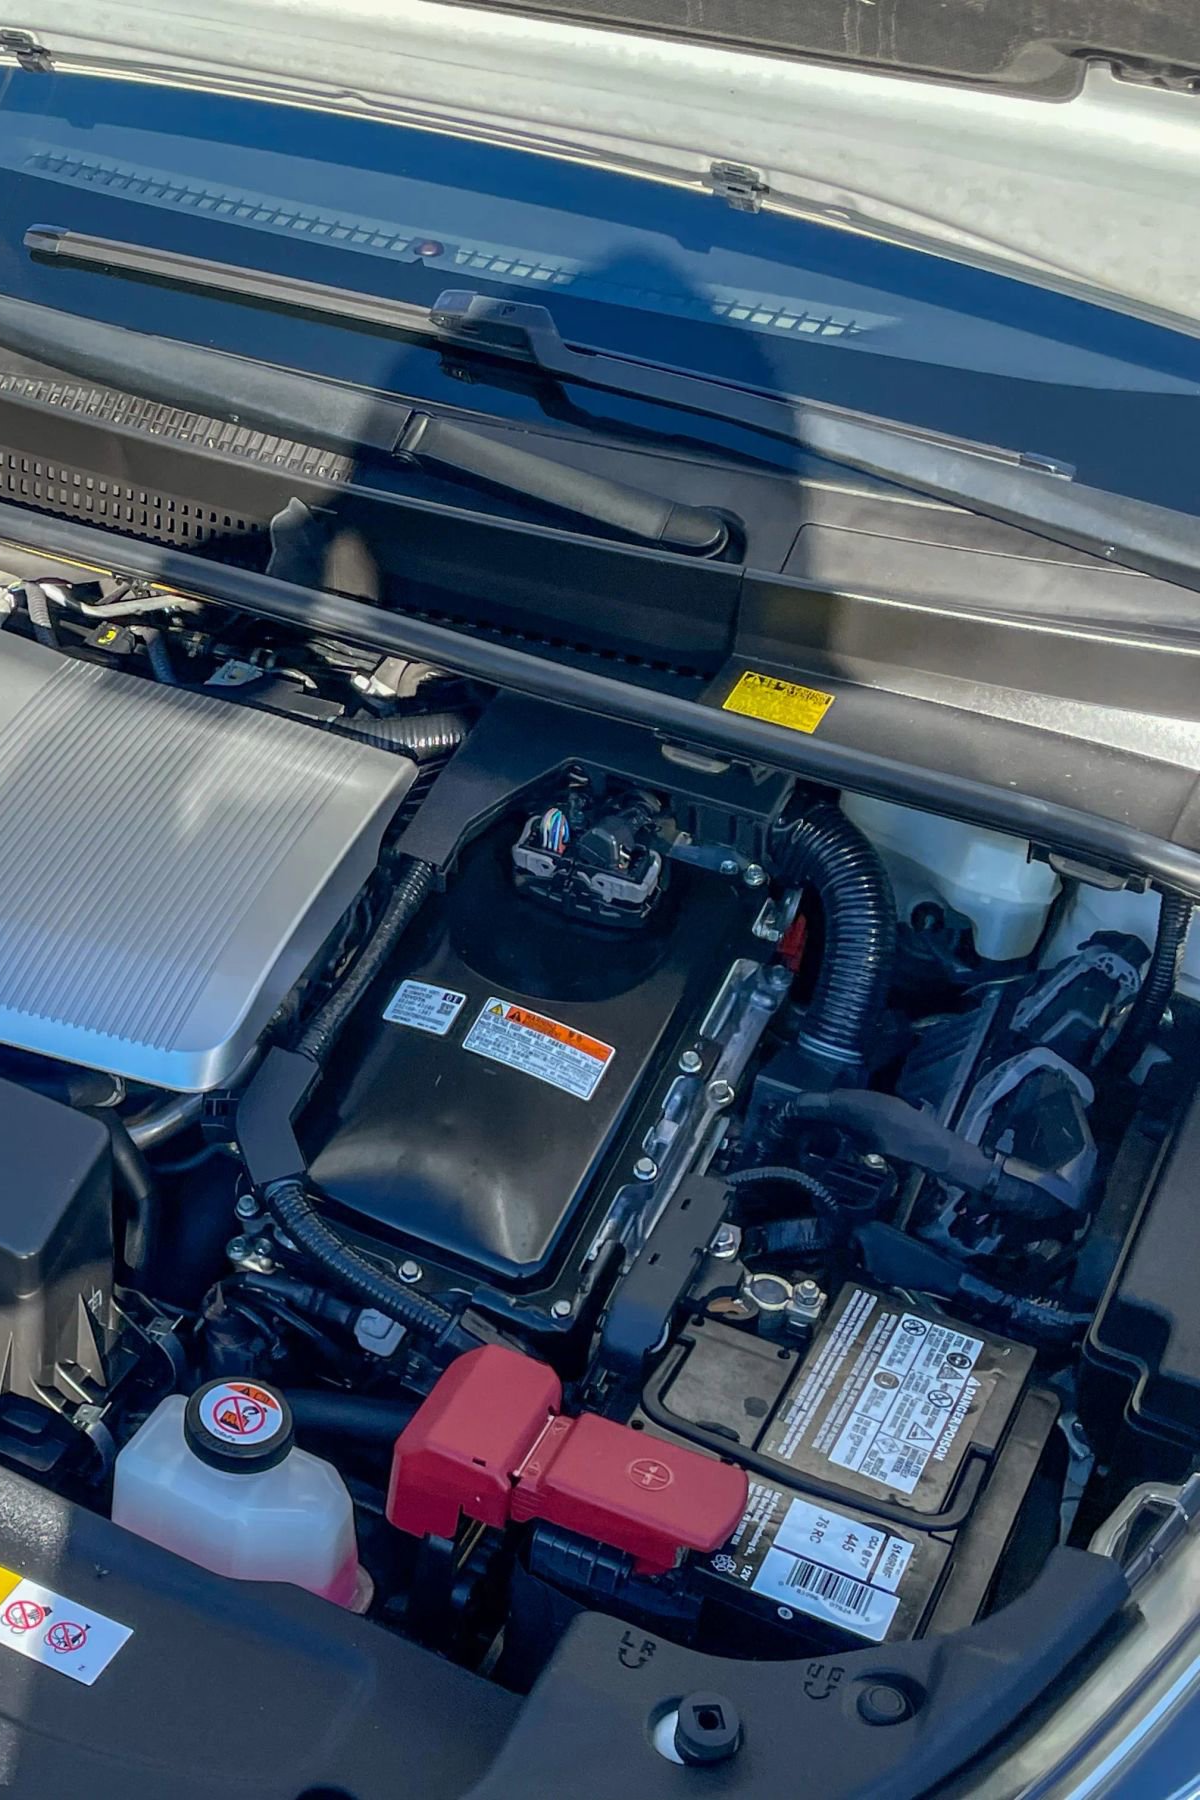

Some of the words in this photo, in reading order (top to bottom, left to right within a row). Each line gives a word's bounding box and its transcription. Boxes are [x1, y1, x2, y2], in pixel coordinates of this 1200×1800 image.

[950, 1387, 976, 1425] DANGER
[933, 1424, 959, 1461] POISON
[814, 1516, 829, 1529] 76
[808, 1527, 824, 1544] RC
[840, 1532, 859, 1553] 445
[738, 1563, 754, 1581] 12V
[621, 1630, 635, 1648] L
[640, 1640, 656, 1656] R
